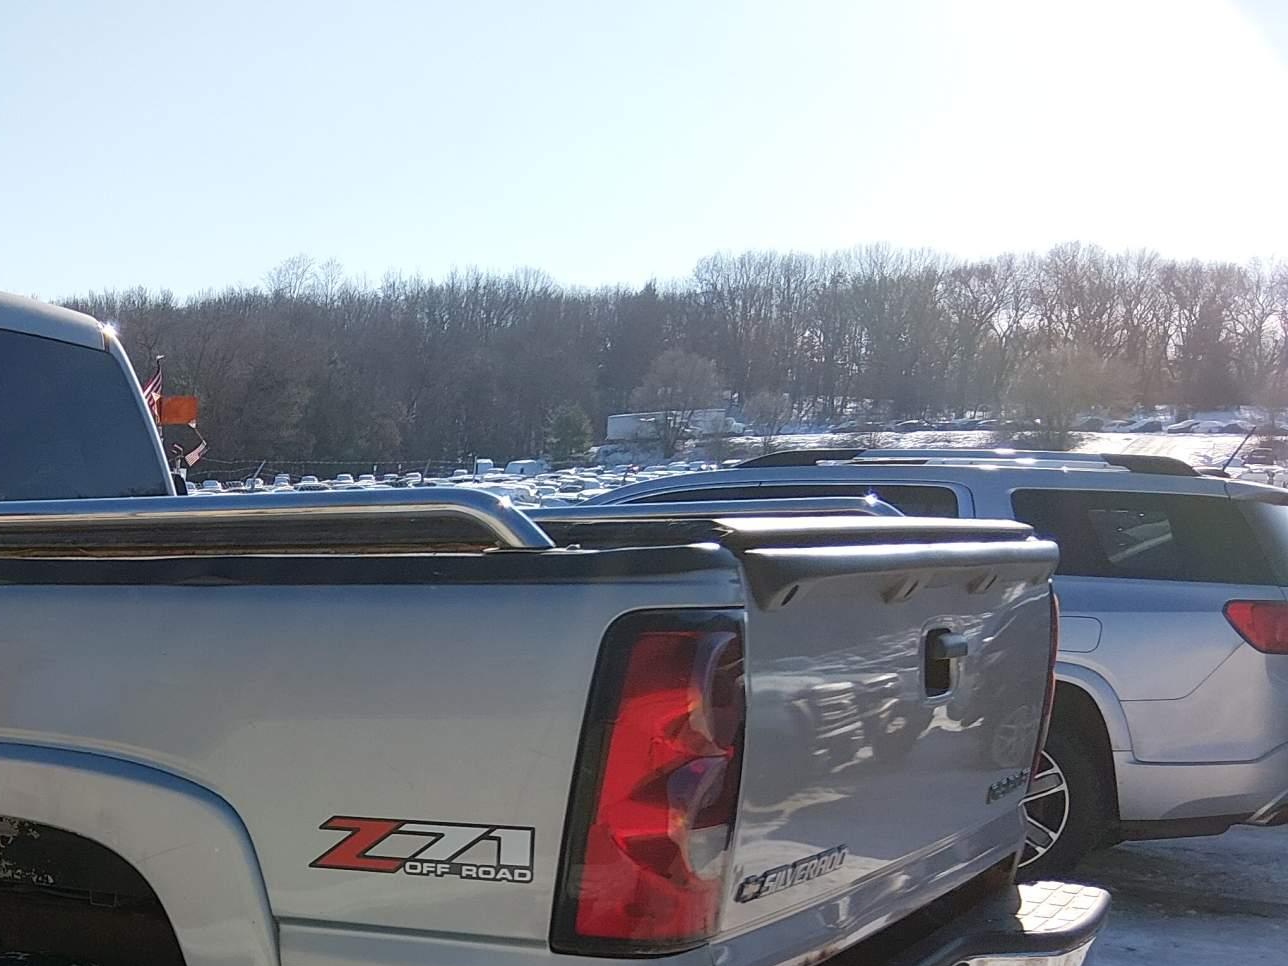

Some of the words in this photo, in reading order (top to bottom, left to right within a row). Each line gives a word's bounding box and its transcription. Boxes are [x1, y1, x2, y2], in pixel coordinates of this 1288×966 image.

[309, 815, 535, 873] Z71
[404, 860, 450, 877] OFF
[461, 864, 533, 882] ROAD
